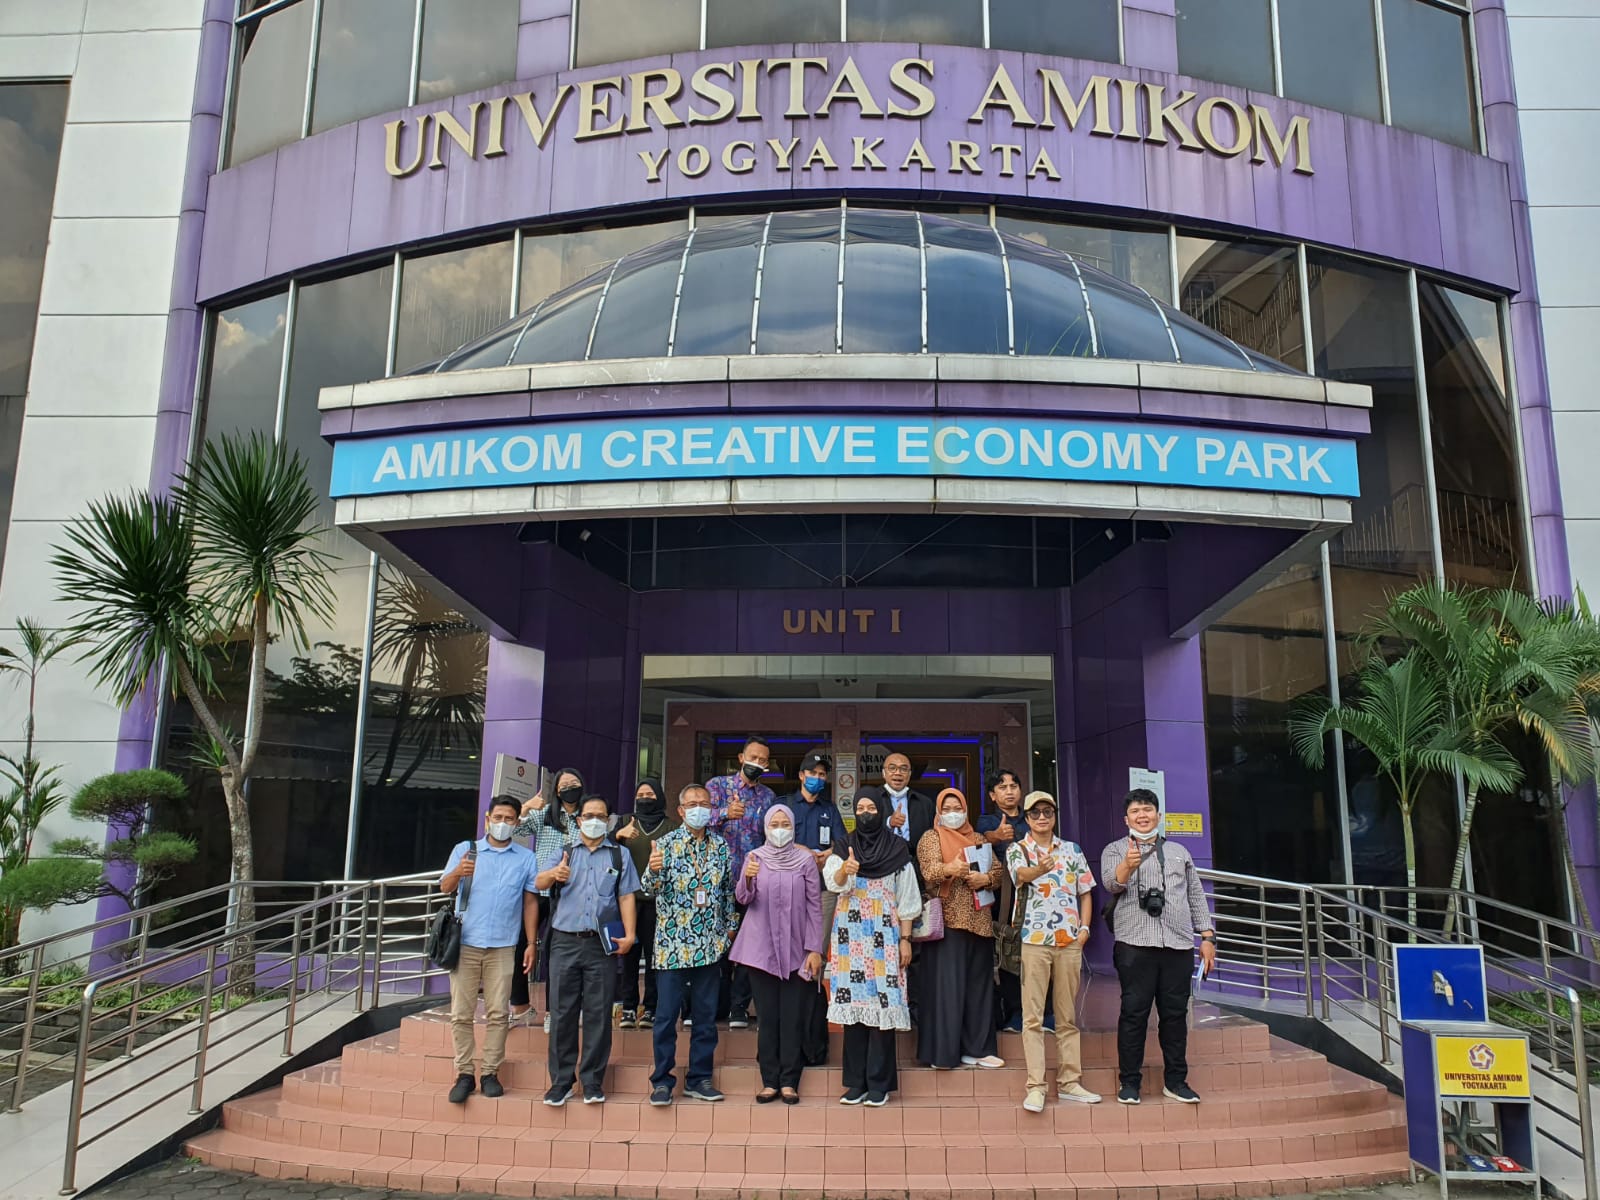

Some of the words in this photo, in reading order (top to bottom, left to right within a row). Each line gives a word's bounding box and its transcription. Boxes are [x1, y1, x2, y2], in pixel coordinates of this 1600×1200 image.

[384, 55, 935, 178] UNIVERSITAS
[968, 63, 1315, 177] AMIKOM
[638, 137, 1062, 183] YOGYAKARTA
[373, 433, 582, 483] AMIKOM
[601, 425, 876, 468] CREATIVE
[897, 425, 1178, 472] ECONOMY
[1196, 437, 1332, 484] PARK
[783, 609, 875, 634] UNIT
[890, 609, 901, 633] I
[1444, 1072, 1491, 1082] UNIVERSITAS
[1492, 1074, 1523, 1083] AMIKOM
[1461, 1081, 1507, 1090] YOGYAKARTA
